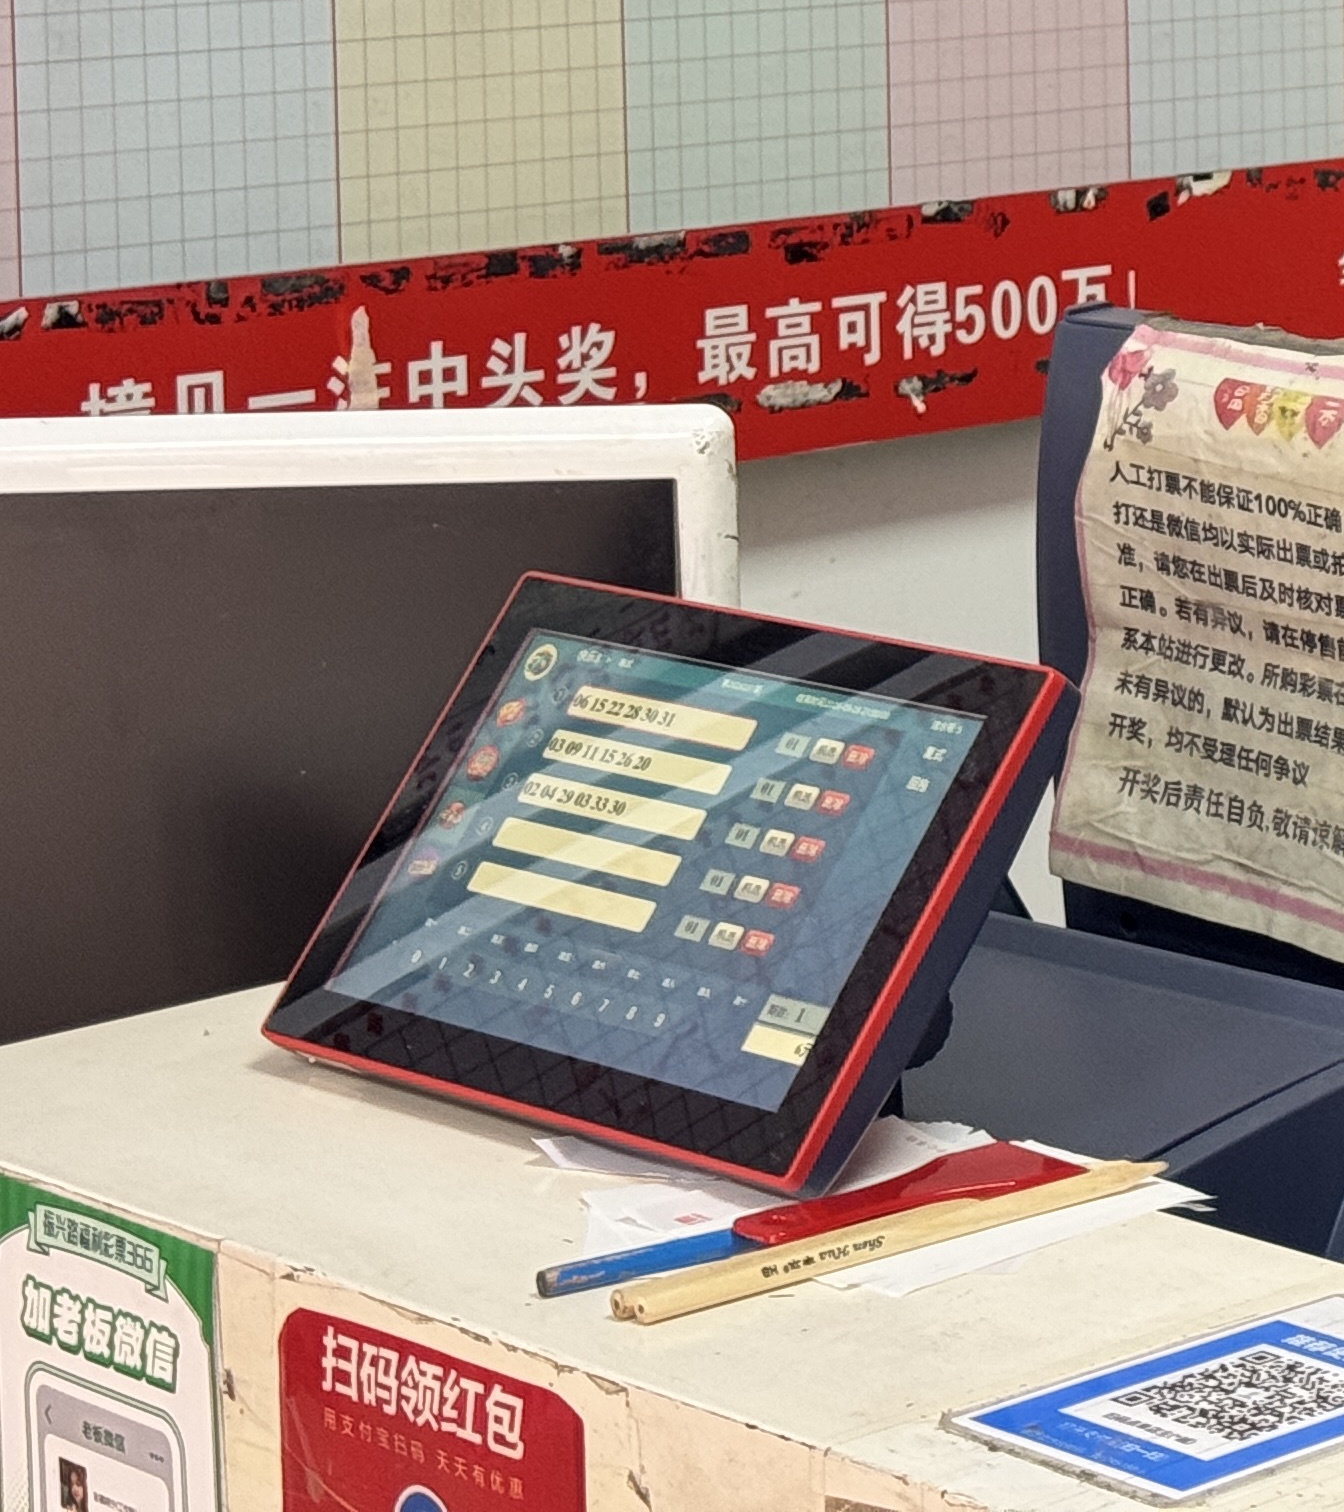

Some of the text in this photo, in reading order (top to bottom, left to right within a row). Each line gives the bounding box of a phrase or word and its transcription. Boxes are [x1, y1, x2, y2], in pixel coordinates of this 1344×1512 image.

[22, 1275, 179, 1388] 加老板微信
[321, 1325, 526, 1461] 扫码领红包
